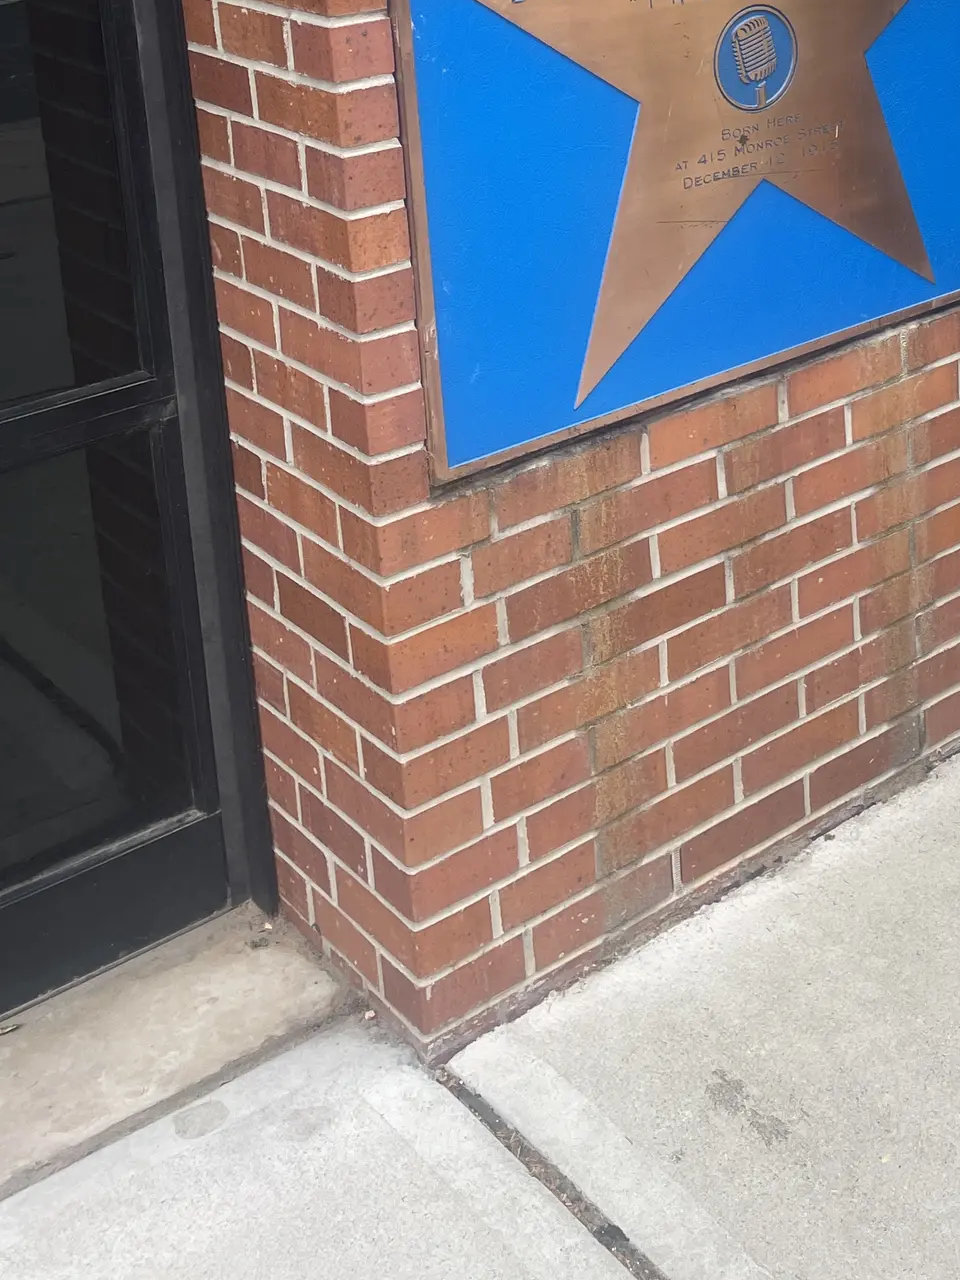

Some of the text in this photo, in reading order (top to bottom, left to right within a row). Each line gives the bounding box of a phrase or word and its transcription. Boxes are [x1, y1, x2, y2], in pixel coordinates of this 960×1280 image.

[721, 112, 802, 142] BORN HERE
[675, 160, 689, 172] AT
[697, 148, 727, 166] 415
[734, 133, 792, 158] MONROE
[683, 161, 759, 191] DECEMBER
